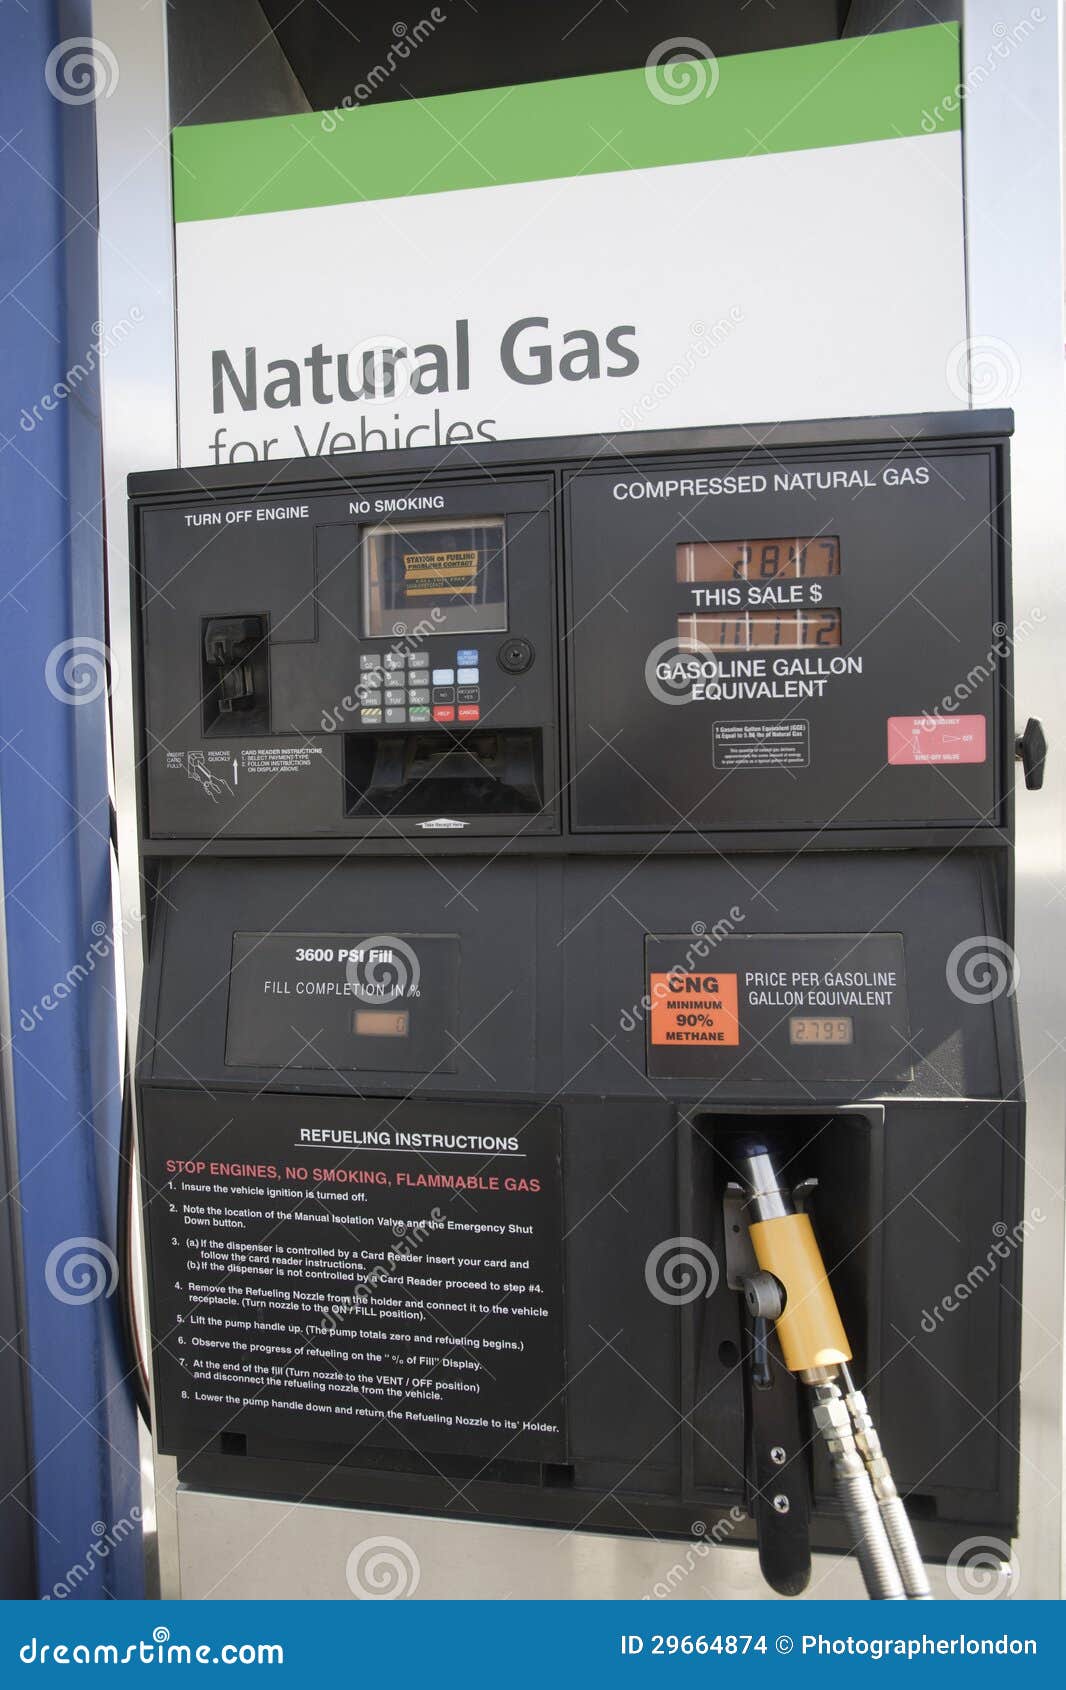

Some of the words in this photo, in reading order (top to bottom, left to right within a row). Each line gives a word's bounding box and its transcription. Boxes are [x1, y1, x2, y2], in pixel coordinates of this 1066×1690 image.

[211, 319, 470, 414] Natural
[500, 316, 640, 385] Gas
[209, 428, 278, 465] for
[294, 409, 497, 458] Vehicles
[613, 476, 766, 501] COMPRESSED
[774, 470, 876, 492] NATURAL
[882, 468, 929, 486] GAS
[349, 500, 370, 515] NO
[374, 496, 444, 513] SMOKING
[184, 512, 221, 527] TURN
[225, 510, 252, 524] OFF
[256, 506, 309, 522] ENGINE
[690, 587, 741, 607] THIS
[747, 585, 803, 604] SALE
[809, 583, 822, 603] $
[656, 660, 766, 680] GASOLINE
[772, 656, 862, 677] GALLON
[692, 680, 827, 701] EQUIVALENT
[295, 948, 333, 962] 3600
[338, 949, 365, 963] PSI
[368, 950, 392, 963] Fill
[264, 981, 290, 994] FILL
[296, 982, 384, 996] COMPLETION
[391, 984, 404, 996] IN
[407, 984, 421, 998] %
[668, 976, 719, 993] CNG
[745, 972, 787, 987] PRICE
[792, 972, 819, 987] PER
[824, 972, 896, 987] GASOLINE
[667, 1001, 722, 1010] MINIMUM
[748, 991, 803, 1006] GALLON
[807, 991, 892, 1006] EQUIVALENT
[676, 1014, 714, 1027] 90%
[666, 1032, 725, 1041] METHANE
[300, 1128, 390, 1145] REFUELING
[395, 1132, 518, 1151] INSTRUCTIONS
[166, 1160, 205, 1175] STOP
[210, 1162, 280, 1181] ENGINES,
[285, 1166, 308, 1180] NO
[312, 1167, 391, 1186] SMOKING,
[396, 1171, 499, 1190] FLAMMABLE
[504, 1177, 540, 1192] GAS
[167, 1182, 176, 1191] 1.
[181, 1182, 211, 1193] Insure
[213, 1184, 228, 1194] the
[230, 1186, 264, 1196] vehicle
[266, 1187, 302, 1199] ignition
[305, 1189, 314, 1199] is
[316, 1190, 348, 1201] turned
[351, 1192, 367, 1202] off.
[169, 1203, 177, 1213] 2.
[183, 1204, 204, 1215] Note
[206, 1206, 222, 1216] the
[224, 1207, 262, 1218] location
[264, 1209, 274, 1219] of
[276, 1210, 292, 1220] the
[294, 1211, 329, 1222] Manual
[332, 1213, 374, 1225] Isolation
[376, 1215, 404, 1227] Valve
[406, 1218, 426, 1228] and
[428, 1218, 444, 1229] the
[447, 1220, 505, 1235] Emergency
[508, 1223, 533, 1234] Shut
[184, 1216, 210, 1226] Down
[212, 1217, 246, 1229] button.
[171, 1237, 179, 1247] 3.
[186, 1238, 199, 1250] (a.)
[200, 1239, 206, 1249] If
[208, 1240, 224, 1250] the
[226, 1241, 272, 1253] dispenser
[275, 1244, 284, 1254] is
[286, 1245, 334, 1257] controlled
[337, 1248, 349, 1260] by
[352, 1250, 358, 1258] a
[360, 1249, 384, 1260] Card
[387, 1251, 422, 1262] Reader
[426, 1253, 455, 1264] insert
[457, 1257, 481, 1267] your
[483, 1258, 506, 1268] card
[509, 1259, 529, 1269] and
[200, 1250, 228, 1262] follow
[230, 1252, 246, 1263] the
[248, 1255, 269, 1264] card
[272, 1256, 302, 1266] reader
[305, 1257, 366, 1271] instructions.
[181, 1390, 189, 1400] 8.
[194, 1391, 223, 1403] Lower
[225, 1394, 240, 1405] the
[242, 1397, 269, 1409] pump
[271, 1398, 303, 1410] handle
[305, 1401, 332, 1413] down
[334, 1405, 352, 1415] and
[355, 1406, 385, 1418] return
[386, 1408, 402, 1419] the
[405, 1410, 452, 1425] Refueling
[455, 1414, 488, 1426] Nozzle
[491, 1418, 501, 1428] to
[504, 1419, 519, 1429] its'
[522, 1420, 559, 1433] Holder.
